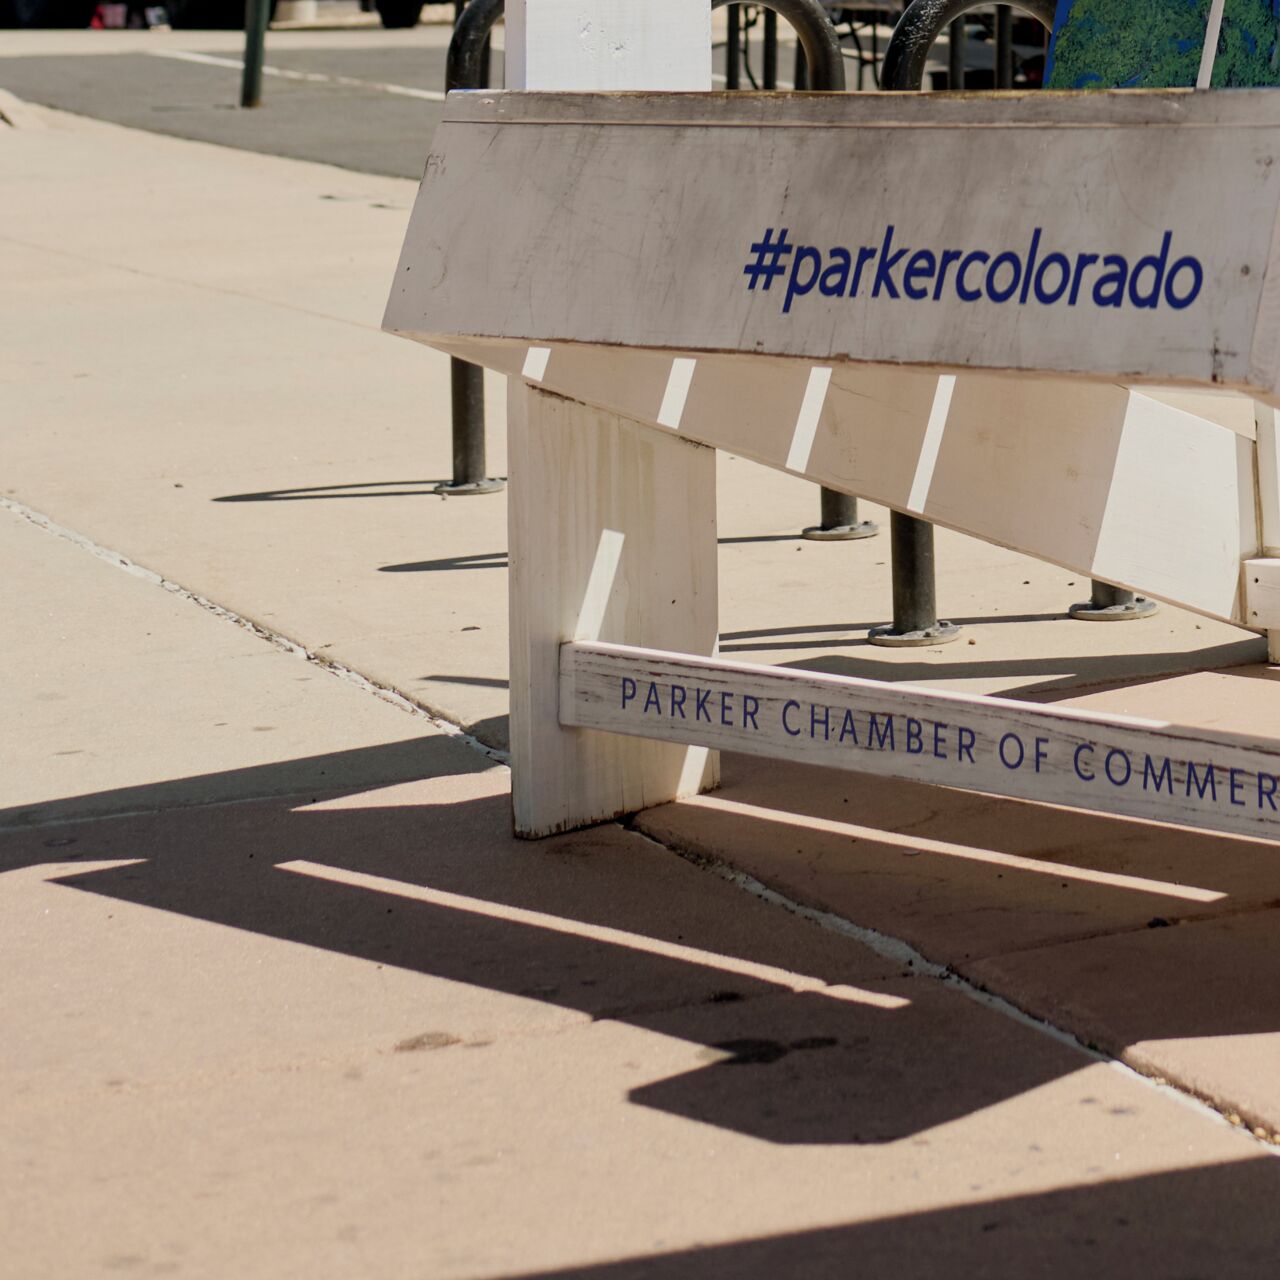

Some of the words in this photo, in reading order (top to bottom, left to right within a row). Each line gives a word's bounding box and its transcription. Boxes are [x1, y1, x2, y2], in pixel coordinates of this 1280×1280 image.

[743, 225, 1204, 314] #parkercolorado
[621, 676, 760, 730] PARKER
[781, 699, 976, 764] CHAMBER
[999, 732, 1049, 773] OF
